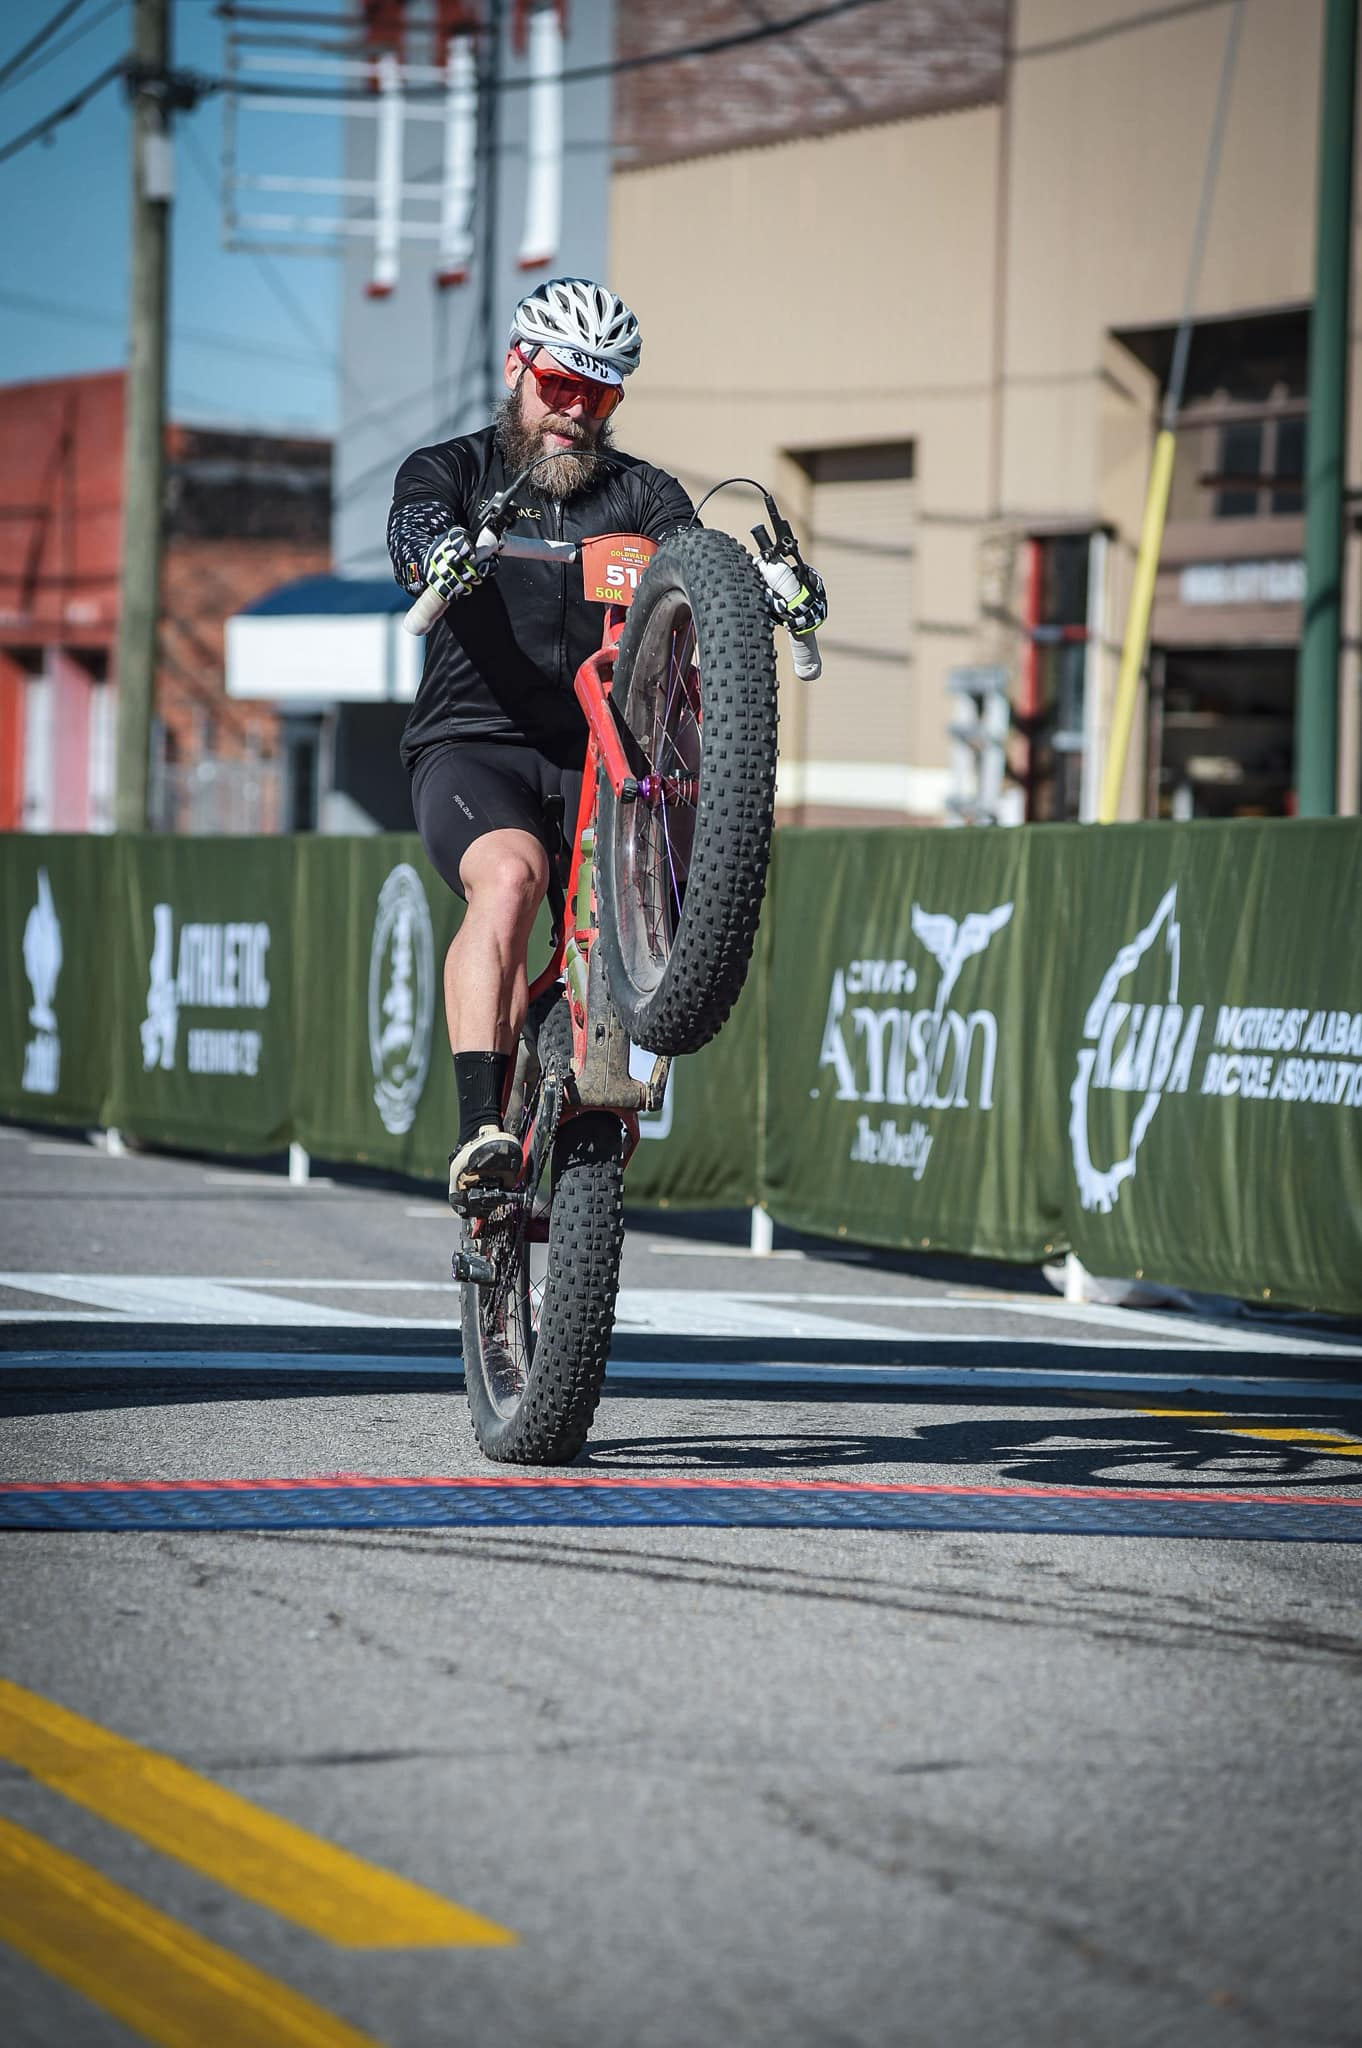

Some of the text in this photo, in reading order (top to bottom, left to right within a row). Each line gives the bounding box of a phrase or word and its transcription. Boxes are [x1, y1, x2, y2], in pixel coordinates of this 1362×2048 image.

[606, 564, 642, 589] 51
[595, 587, 623, 601] 50K
[176, 921, 271, 1008] ATHLETIC
